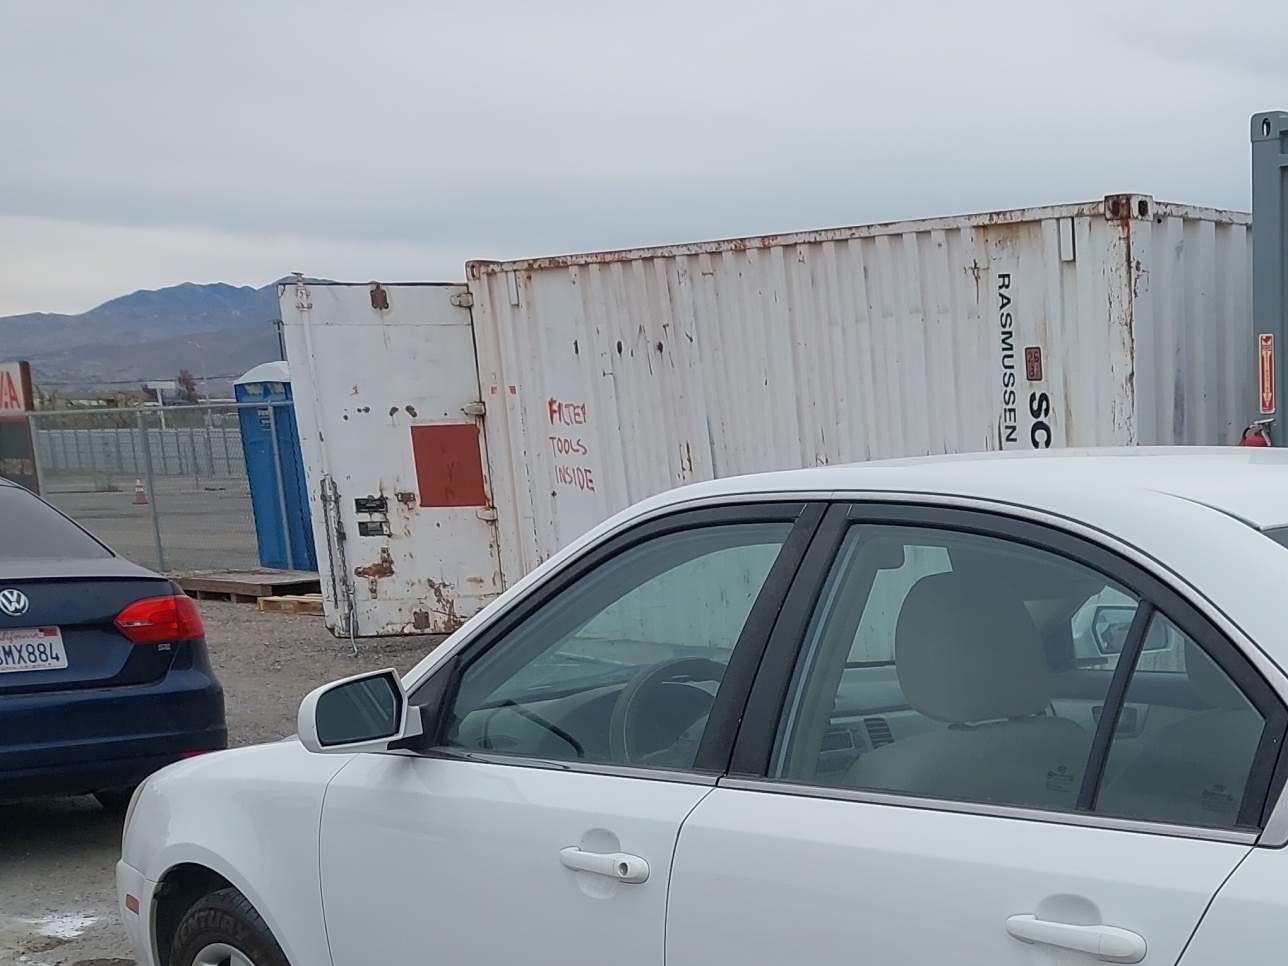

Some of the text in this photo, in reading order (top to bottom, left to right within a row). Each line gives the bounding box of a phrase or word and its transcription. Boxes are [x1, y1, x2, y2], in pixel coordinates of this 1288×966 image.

[998, 273, 1018, 443] RASMUSSEN
[1029, 391, 1051, 449] SC
[549, 436, 587, 457] TOOLS
[555, 464, 595, 492] INSIDE
